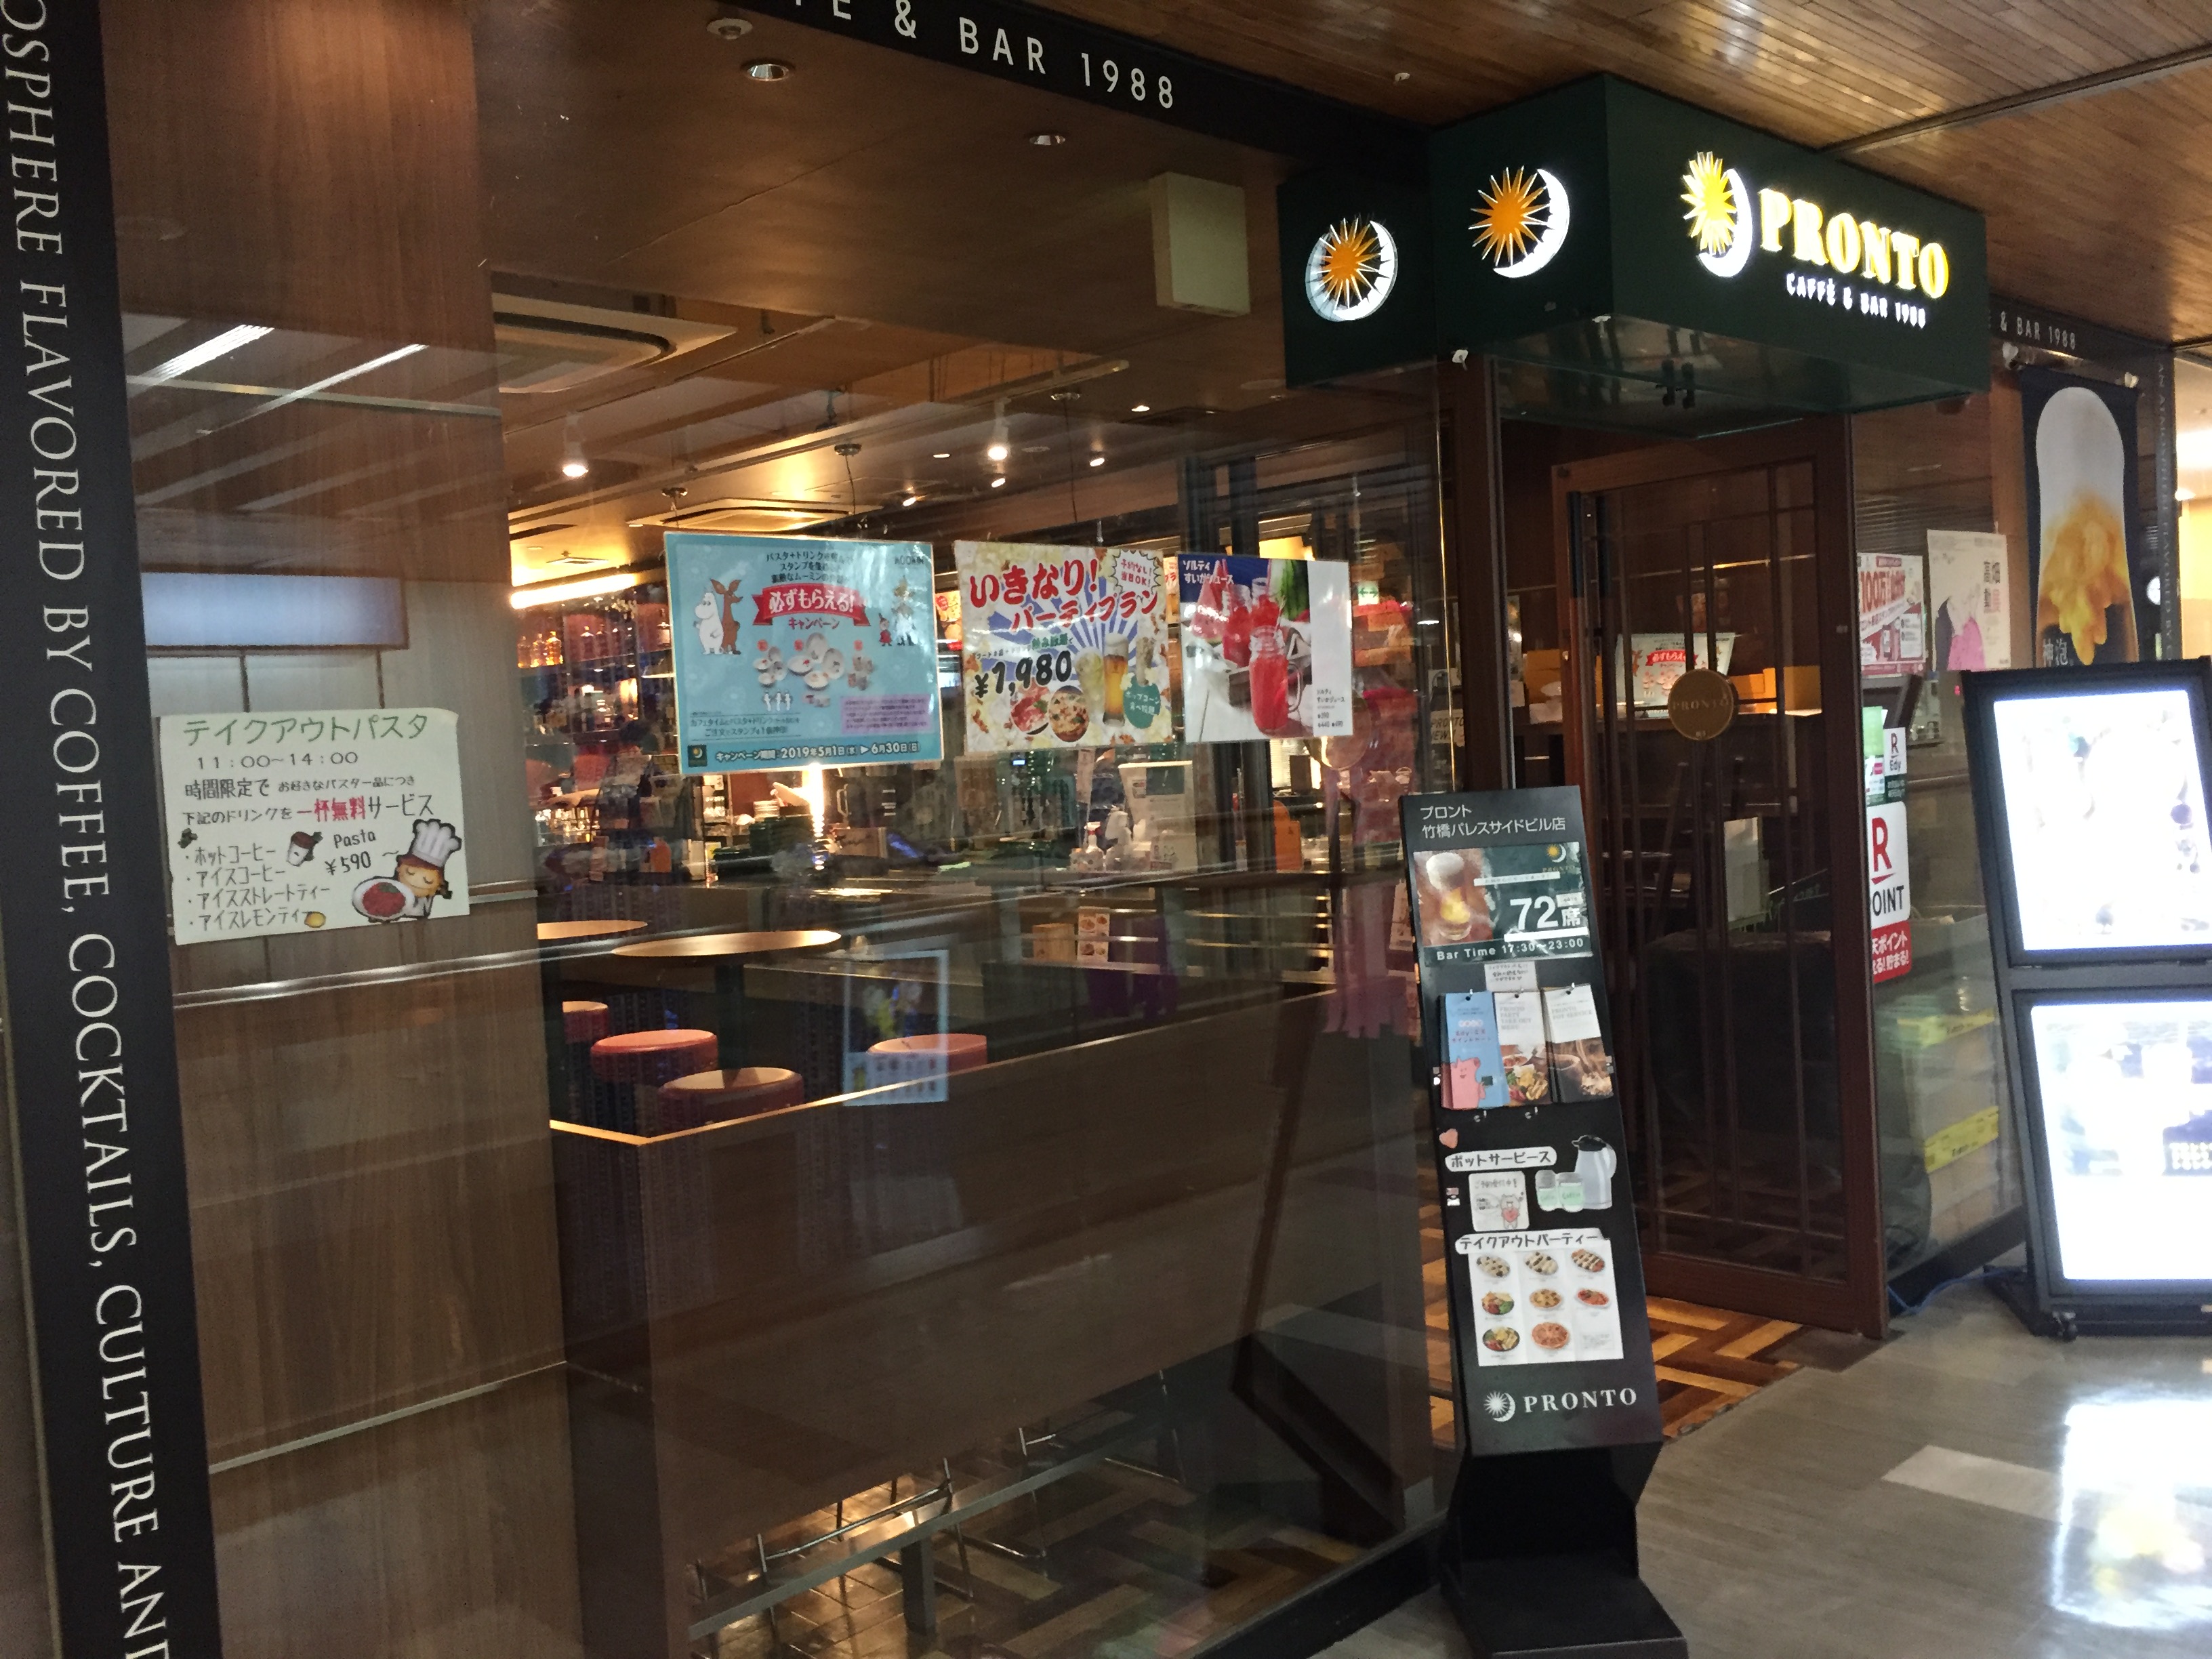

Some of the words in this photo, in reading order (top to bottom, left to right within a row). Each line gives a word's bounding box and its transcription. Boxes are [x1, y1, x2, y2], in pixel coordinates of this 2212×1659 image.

[959, 17, 1046, 75] BAR
[1081, 52, 1173, 108] 1988
[1759, 188, 1949, 299] PRONTO
[1860, 293, 1887, 318] BAR
[1895, 302, 1925, 329] 1988
[2017, 316, 2040, 340] BAR
[2049, 326, 2075, 350] 1988
[20, 281, 85, 581] FLAVORED
[970, 558, 1099, 608] いきなり!
[1183, 560, 1210, 572] ソルティ
[788, 617, 840, 630] キャンペーン
[1011, 590, 1158, 632] パーティプラン
[43, 605, 93, 672] BY
[975, 650, 1072, 699] ¥1,980
[184, 714, 428, 746] テイクアウトパスタ
[49, 688, 110, 914] COFFEE,
[184, 779, 270, 800] 時間限定で
[1420, 804, 1473, 821] プロント
[1421, 817, 1567, 840] 竹橋パレスサイドビル店
[333, 830, 377, 848] Pasta
[1872, 885, 1905, 917] OINT
[1437, 949, 1459, 961] Bar
[1464, 946, 1496, 958] Time
[1872, 930, 1908, 955] 天ポイント
[68, 933, 137, 1267] COCKTAILS,
[1459, 1232, 1599, 1251] テイクアウトパーティー
[96, 1284, 160, 1543] CULTURE
[1523, 1387, 1637, 1414] PRONTO
[117, 1563, 171, 1659] AN
